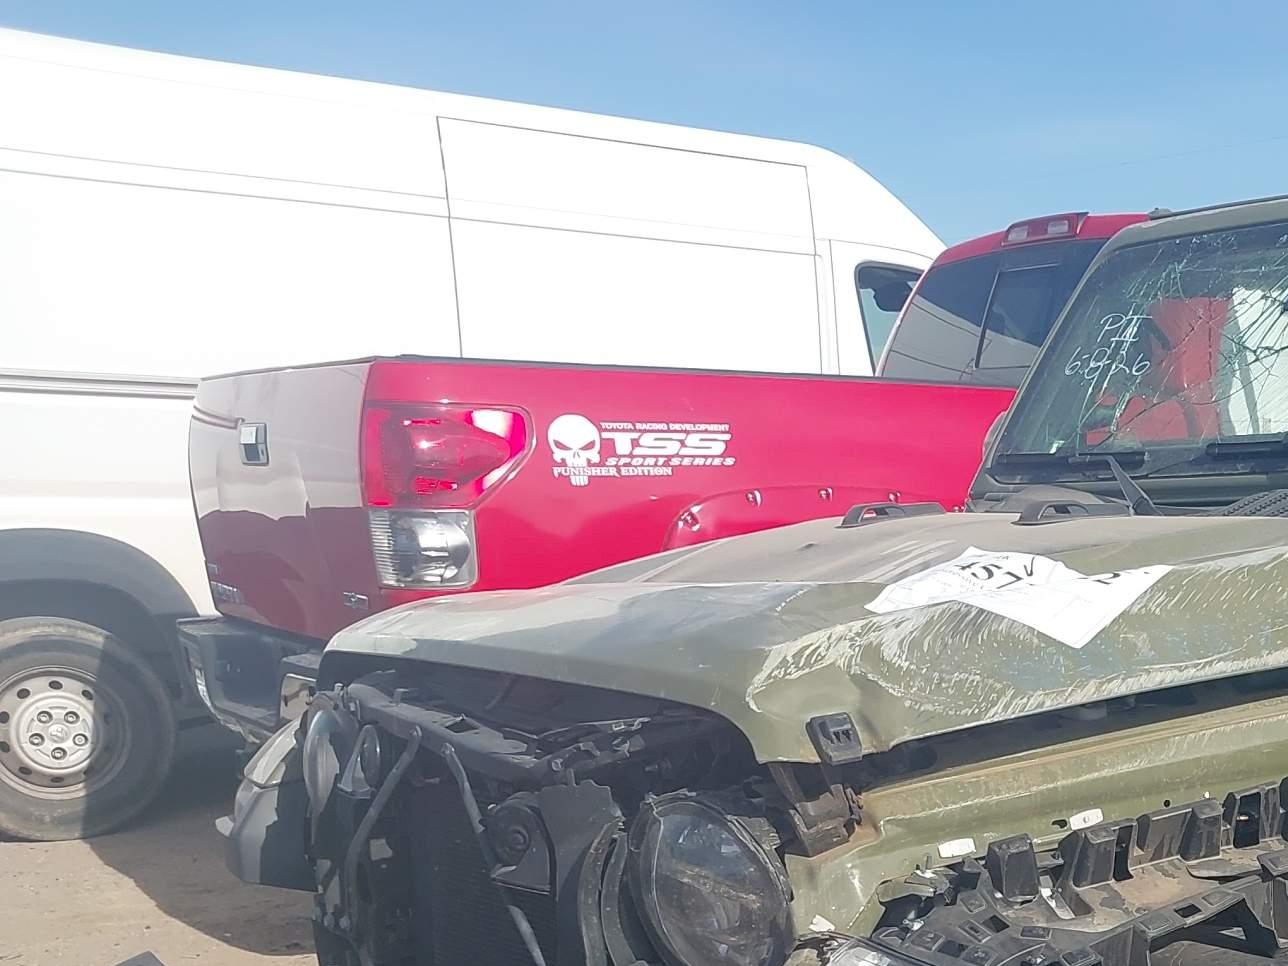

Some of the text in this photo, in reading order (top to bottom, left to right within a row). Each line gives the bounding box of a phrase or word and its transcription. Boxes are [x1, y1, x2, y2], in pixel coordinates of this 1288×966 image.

[600, 422, 730, 432] TOYOTA RACING DEVELOPMENT
[600, 432, 732, 456] TSS
[605, 457, 736, 466] SPORT SERIES
[552, 466, 673, 478] PUNISHER EDITION
